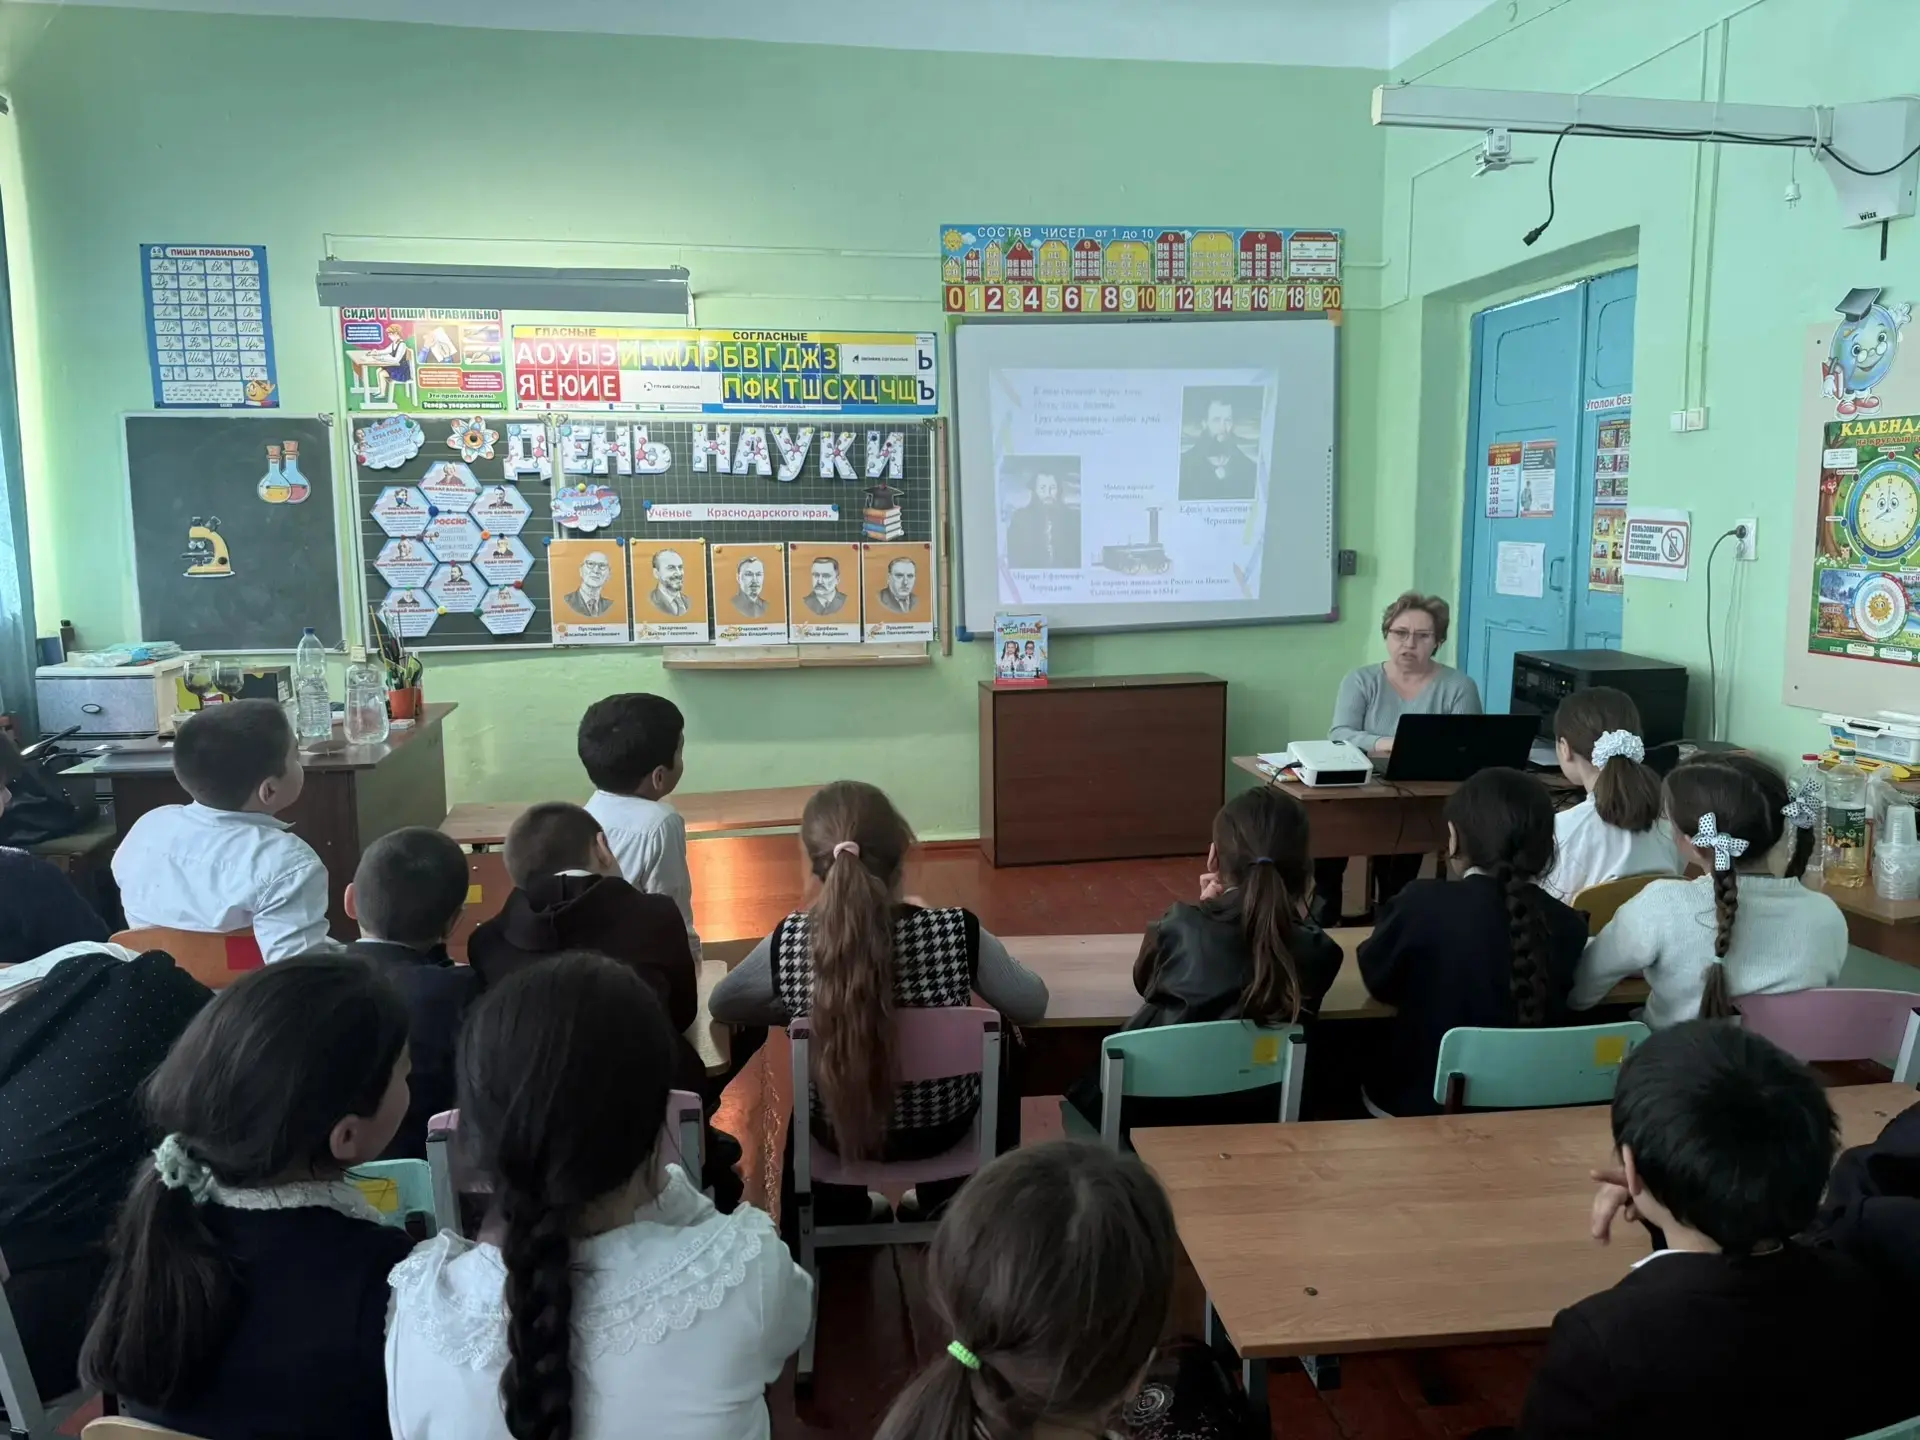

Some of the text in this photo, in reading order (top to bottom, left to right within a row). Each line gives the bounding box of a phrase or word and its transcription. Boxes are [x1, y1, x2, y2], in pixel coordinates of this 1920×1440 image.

[978, 227, 1154, 240] СОСТАВ ЧИСЕЛ от 1 до 10
[948, 286, 1340, 309] 0 1 2 3 4 5 6 7 8 9 10 11 12 13 14 15 16 17 18 19 20
[344, 308, 499, 320] СИДИ И ПИШИ ПРАВИЛЬНО
[535, 328, 596, 337] ГЛАСНЫЕ
[733, 332, 808, 341] СОГЛАСНЫЕ
[1586, 398, 1615, 410] Уголок
[504, 422, 904, 482] ДЕНЬ НАУКИ
[648, 507, 832, 519] Учёные Краснодарского края.
[1488, 507, 1498, 515] 104
[1631, 525, 1663, 533] ПОЛЬЗОВАНИЕ
